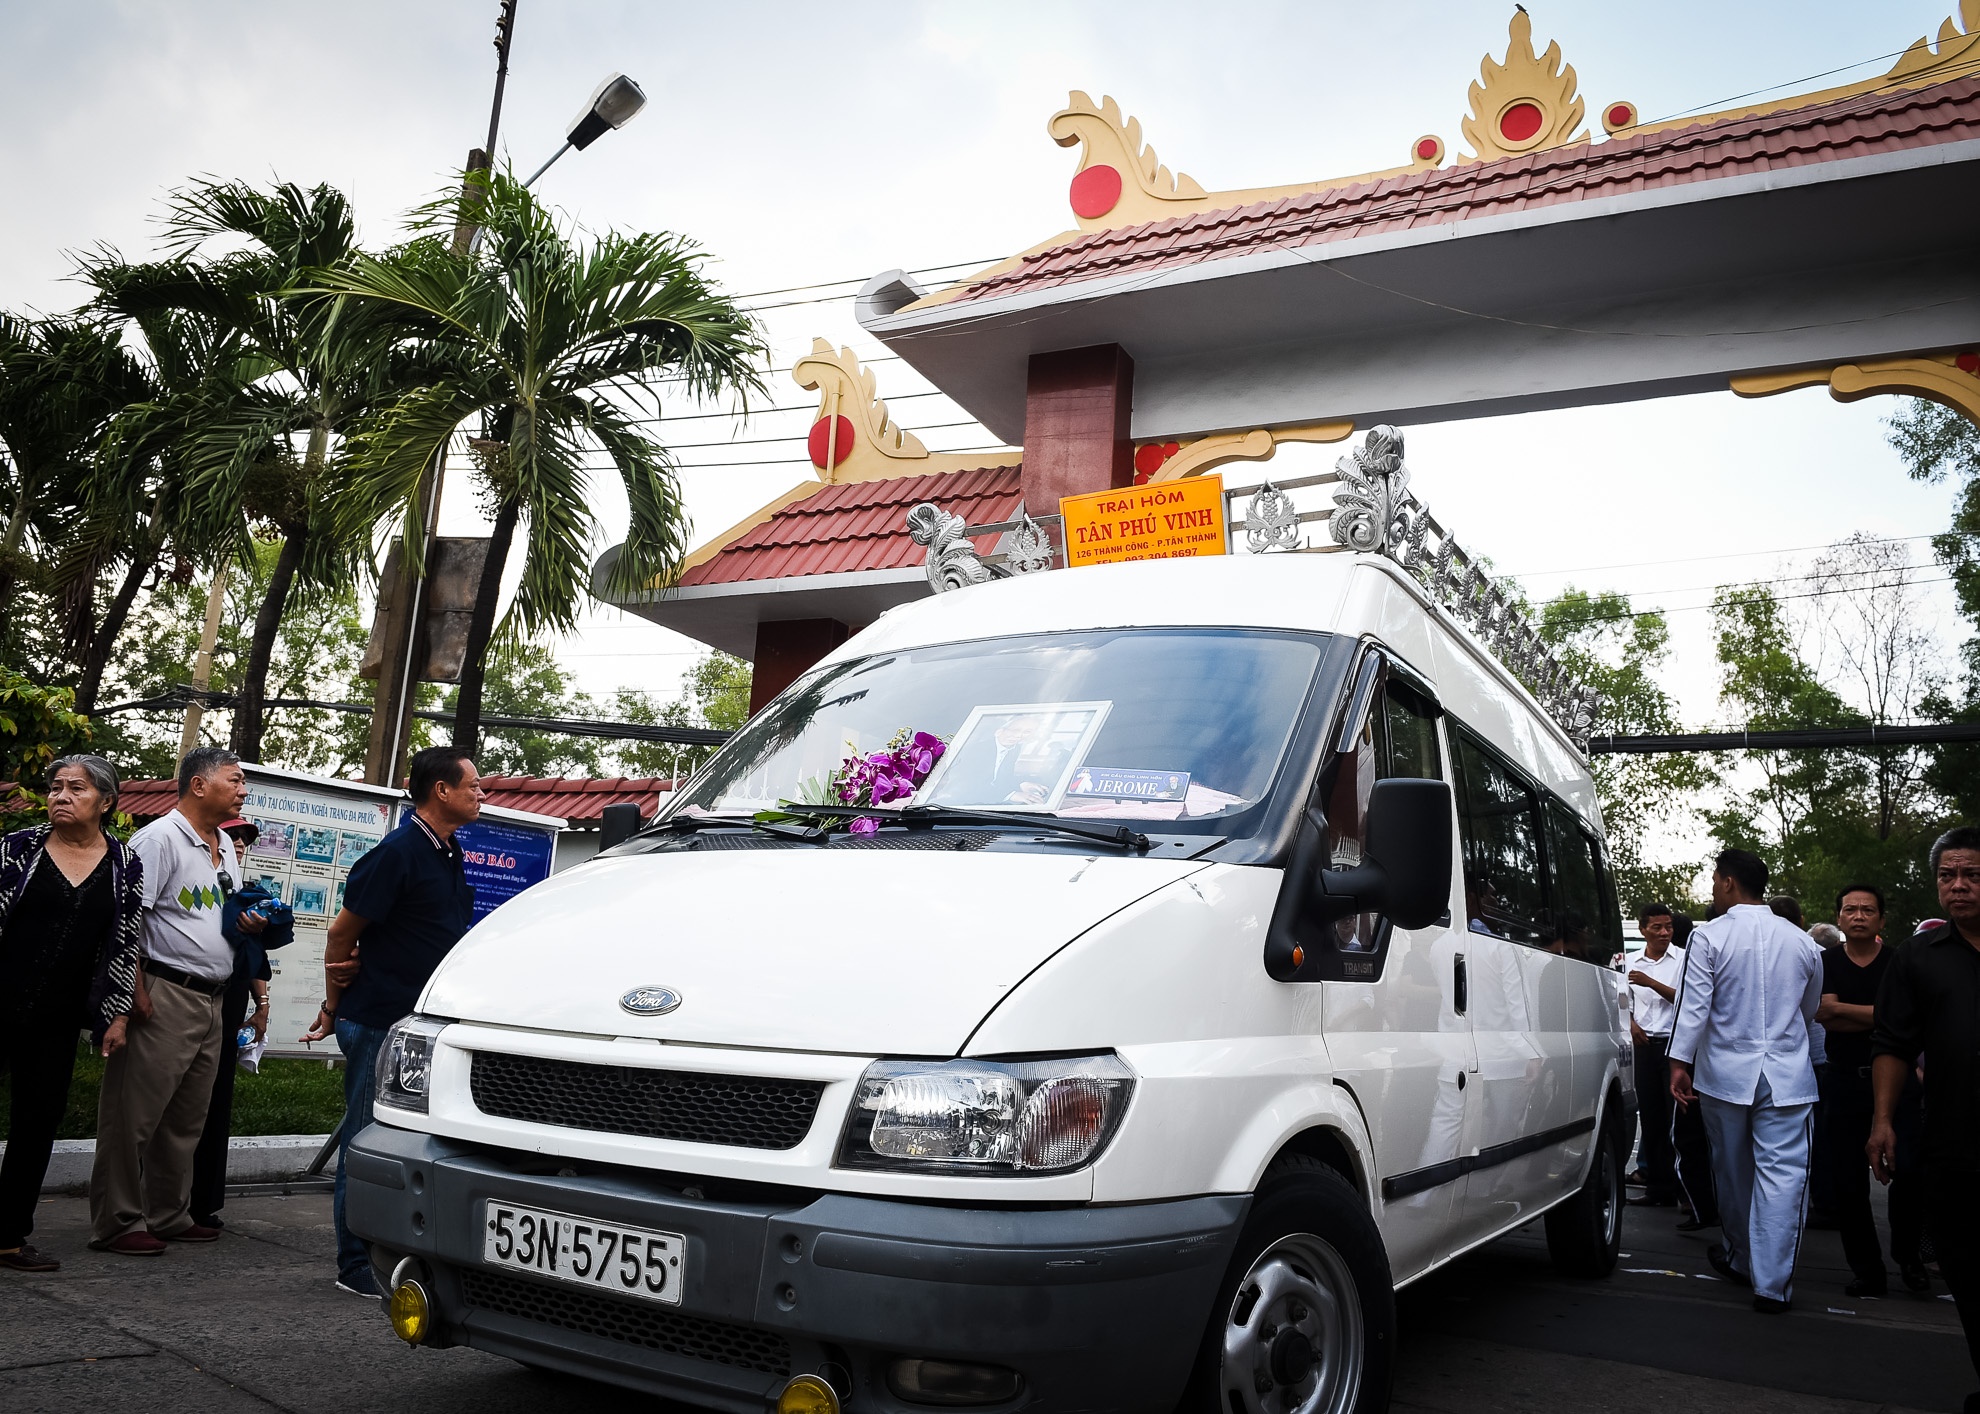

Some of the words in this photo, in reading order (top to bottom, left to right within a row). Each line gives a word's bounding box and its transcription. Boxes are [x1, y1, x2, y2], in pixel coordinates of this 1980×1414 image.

[1097, 499, 1134, 514] TRẠI
[1141, 491, 1185, 508] HÒM
[1076, 521, 1112, 543] TÂN
[1119, 512, 1157, 538] PHÚ
[1163, 508, 1214, 531] VINH
[1076, 549, 1092, 559] 126
[1094, 545, 1123, 556] THÀNH
[1125, 541, 1149, 552] CÔNG
[1186, 532, 1217, 544] THÀNH
[1171, 548, 1198, 558] 8697
[1095, 779, 1158, 795] JEROME
[268, 796, 278, 812] TẠI
[279, 796, 296, 813] CÔNG
[296, 799, 310, 815] VIÊN
[311, 803, 329, 818] NGHĨA
[329, 806, 348, 821] TRANG
[487, 853, 516, 869] BÁO
[1343, 962, 1374, 974] TRANSIT
[629, 989, 667, 1007] Ford
